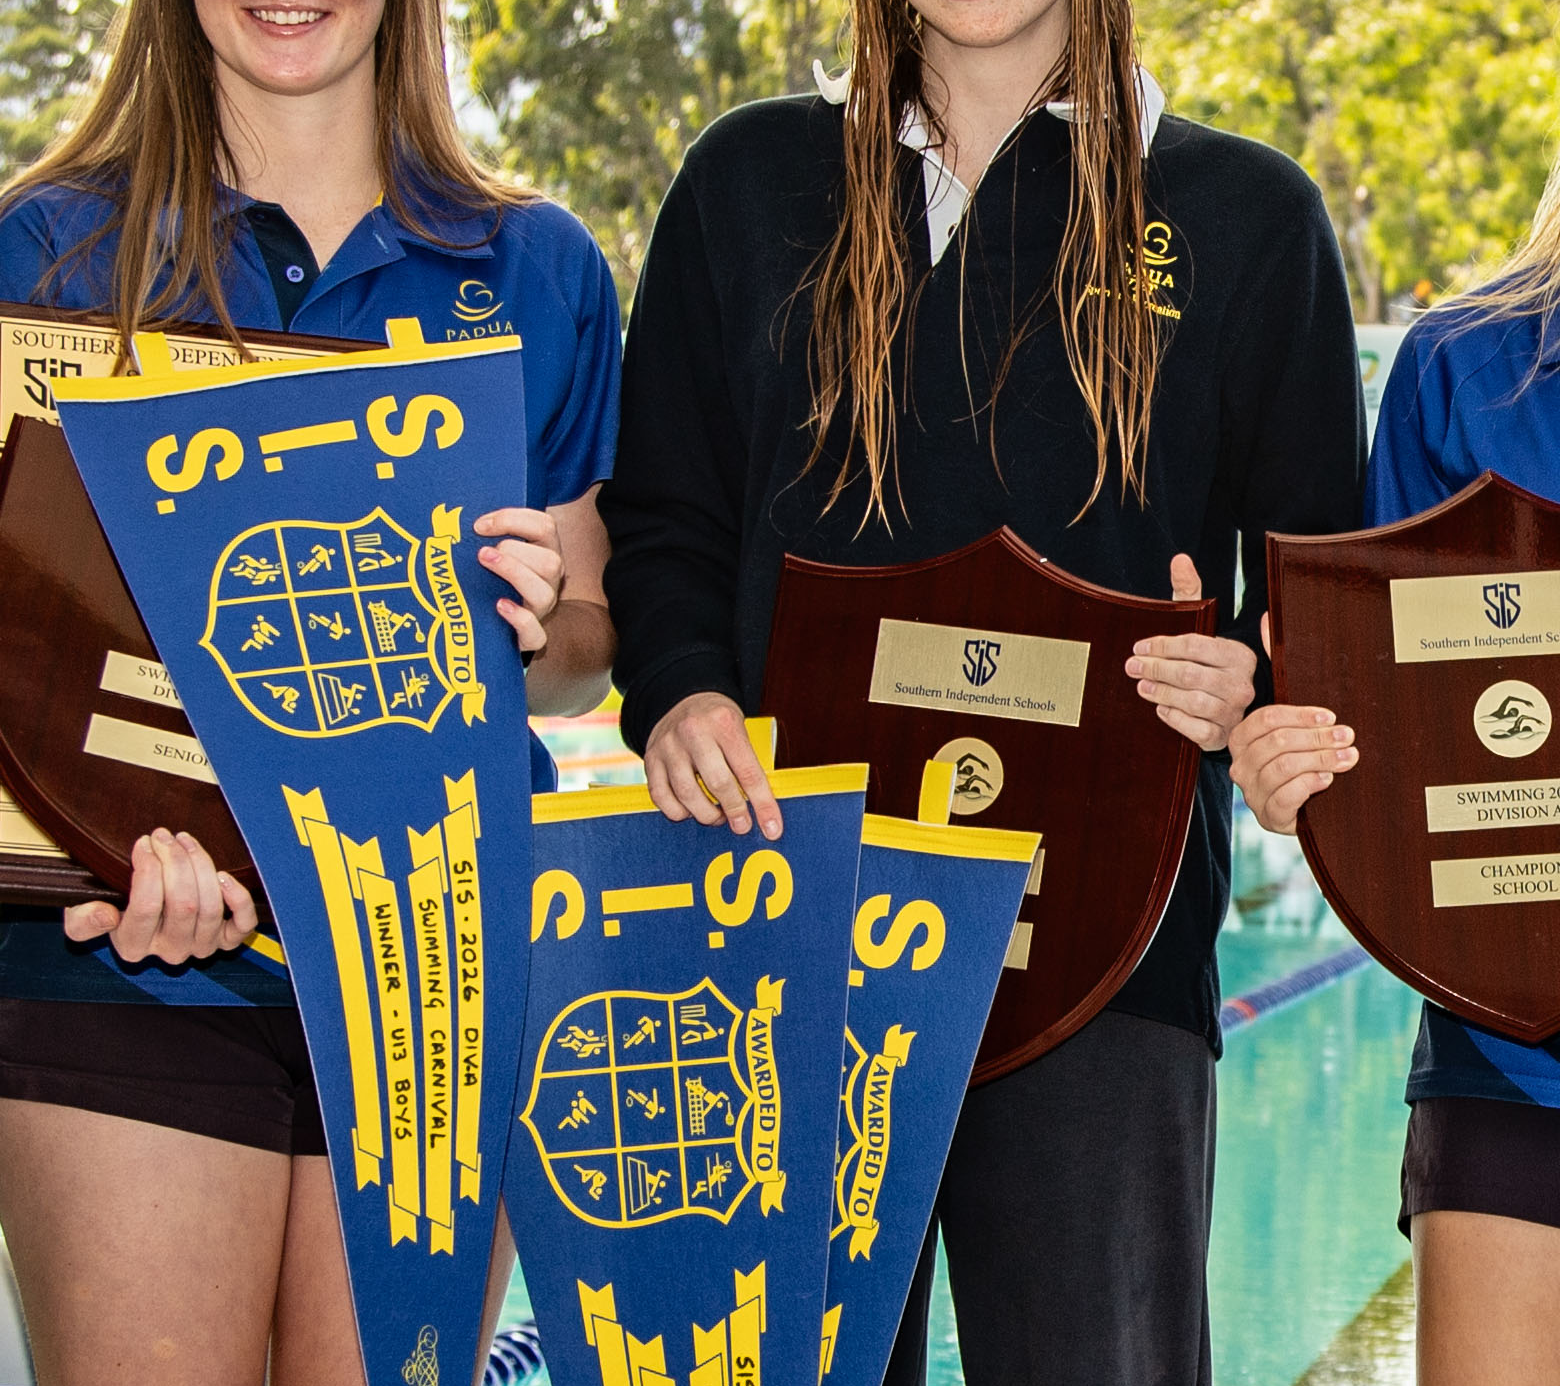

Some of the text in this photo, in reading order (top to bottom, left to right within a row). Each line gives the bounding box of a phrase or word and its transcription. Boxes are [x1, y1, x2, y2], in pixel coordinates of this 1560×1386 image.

[446, 321, 514, 341] PADUA
[429, 545, 471, 684] AWARDED TO
[1420, 636, 1472, 650] Southern
[1474, 632, 1542, 649] Independent
[894, 680, 1056, 712] Southern Independent Schools
[1457, 787, 1546, 806] SWIMMING
[1476, 806, 1550, 822] DIVISION
[1493, 879, 1559, 896] SCHOOL
[375, 903, 412, 1140] WINNER U13 BOYS
[418, 898, 447, 1149] SWIMMING CARNIVAL
[751, 1017, 780, 1173] AWARDED TO
[852, 1061, 889, 1217] AWARDED TO
